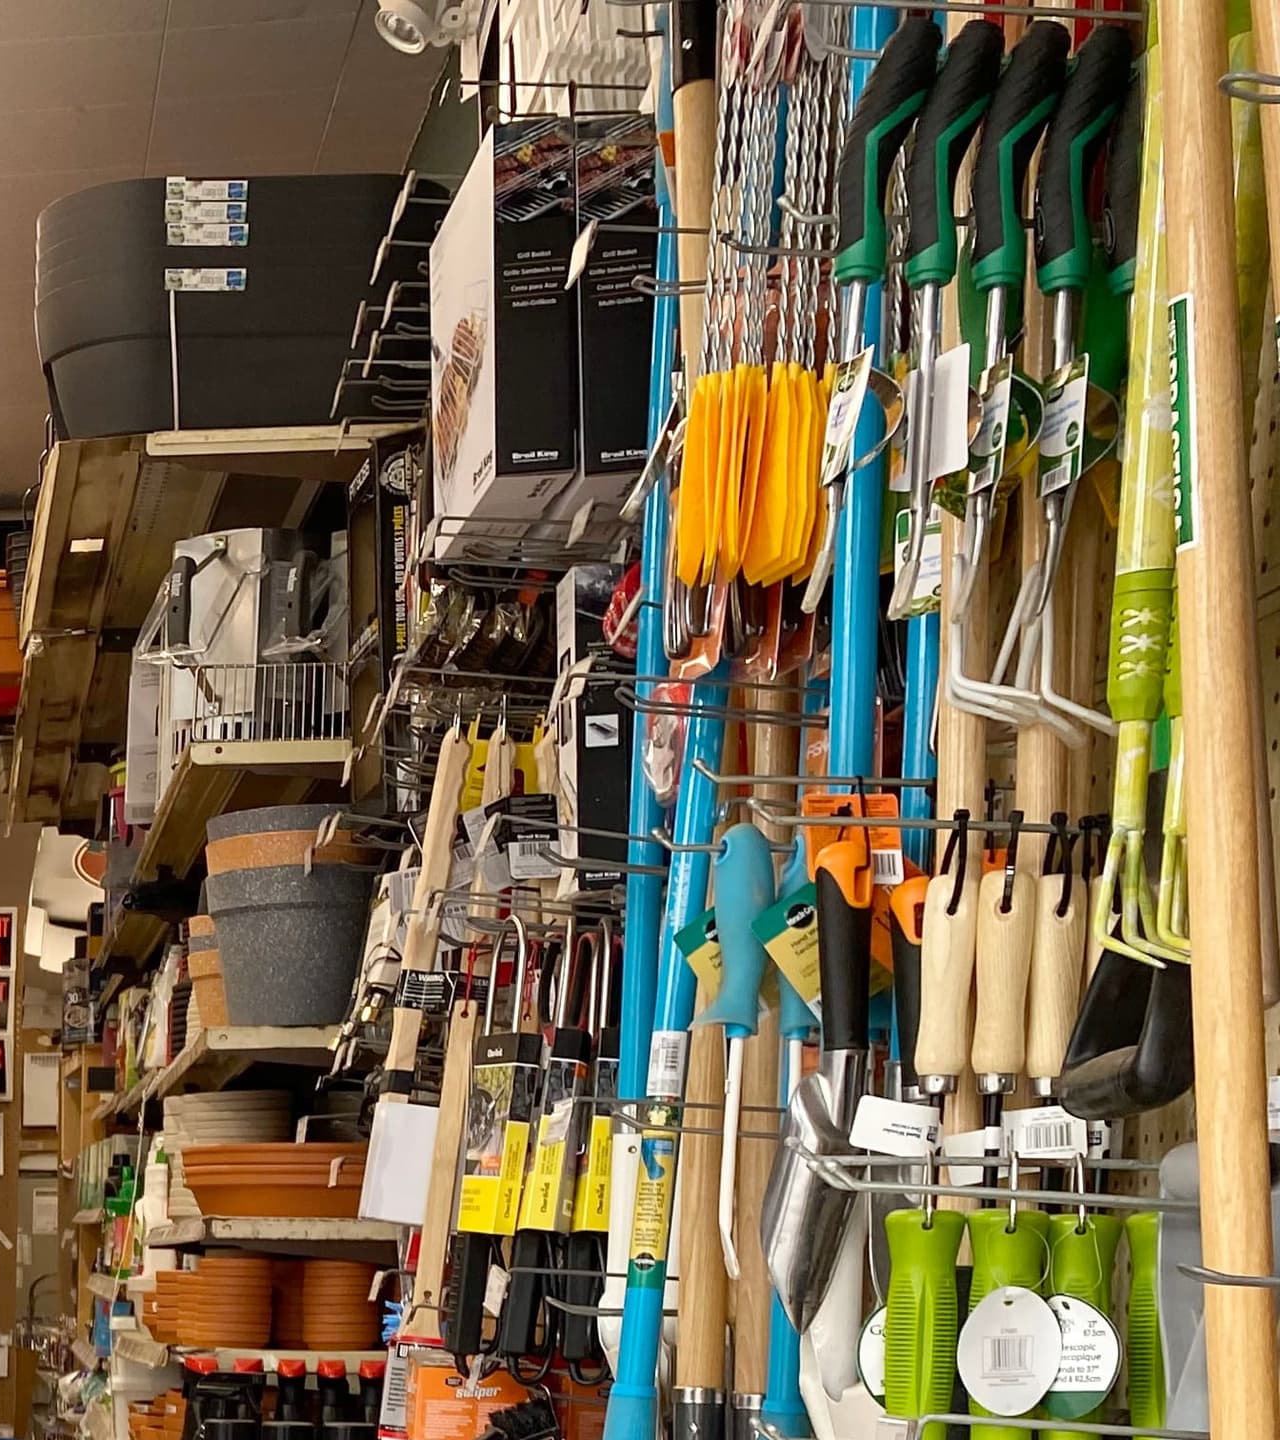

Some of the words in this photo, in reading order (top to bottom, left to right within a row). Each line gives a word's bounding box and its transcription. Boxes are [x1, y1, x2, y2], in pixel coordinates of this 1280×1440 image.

[511, 450, 534, 460] Broil
[536, 449, 559, 461] King
[1061, 1343, 1096, 1353] lescopic
